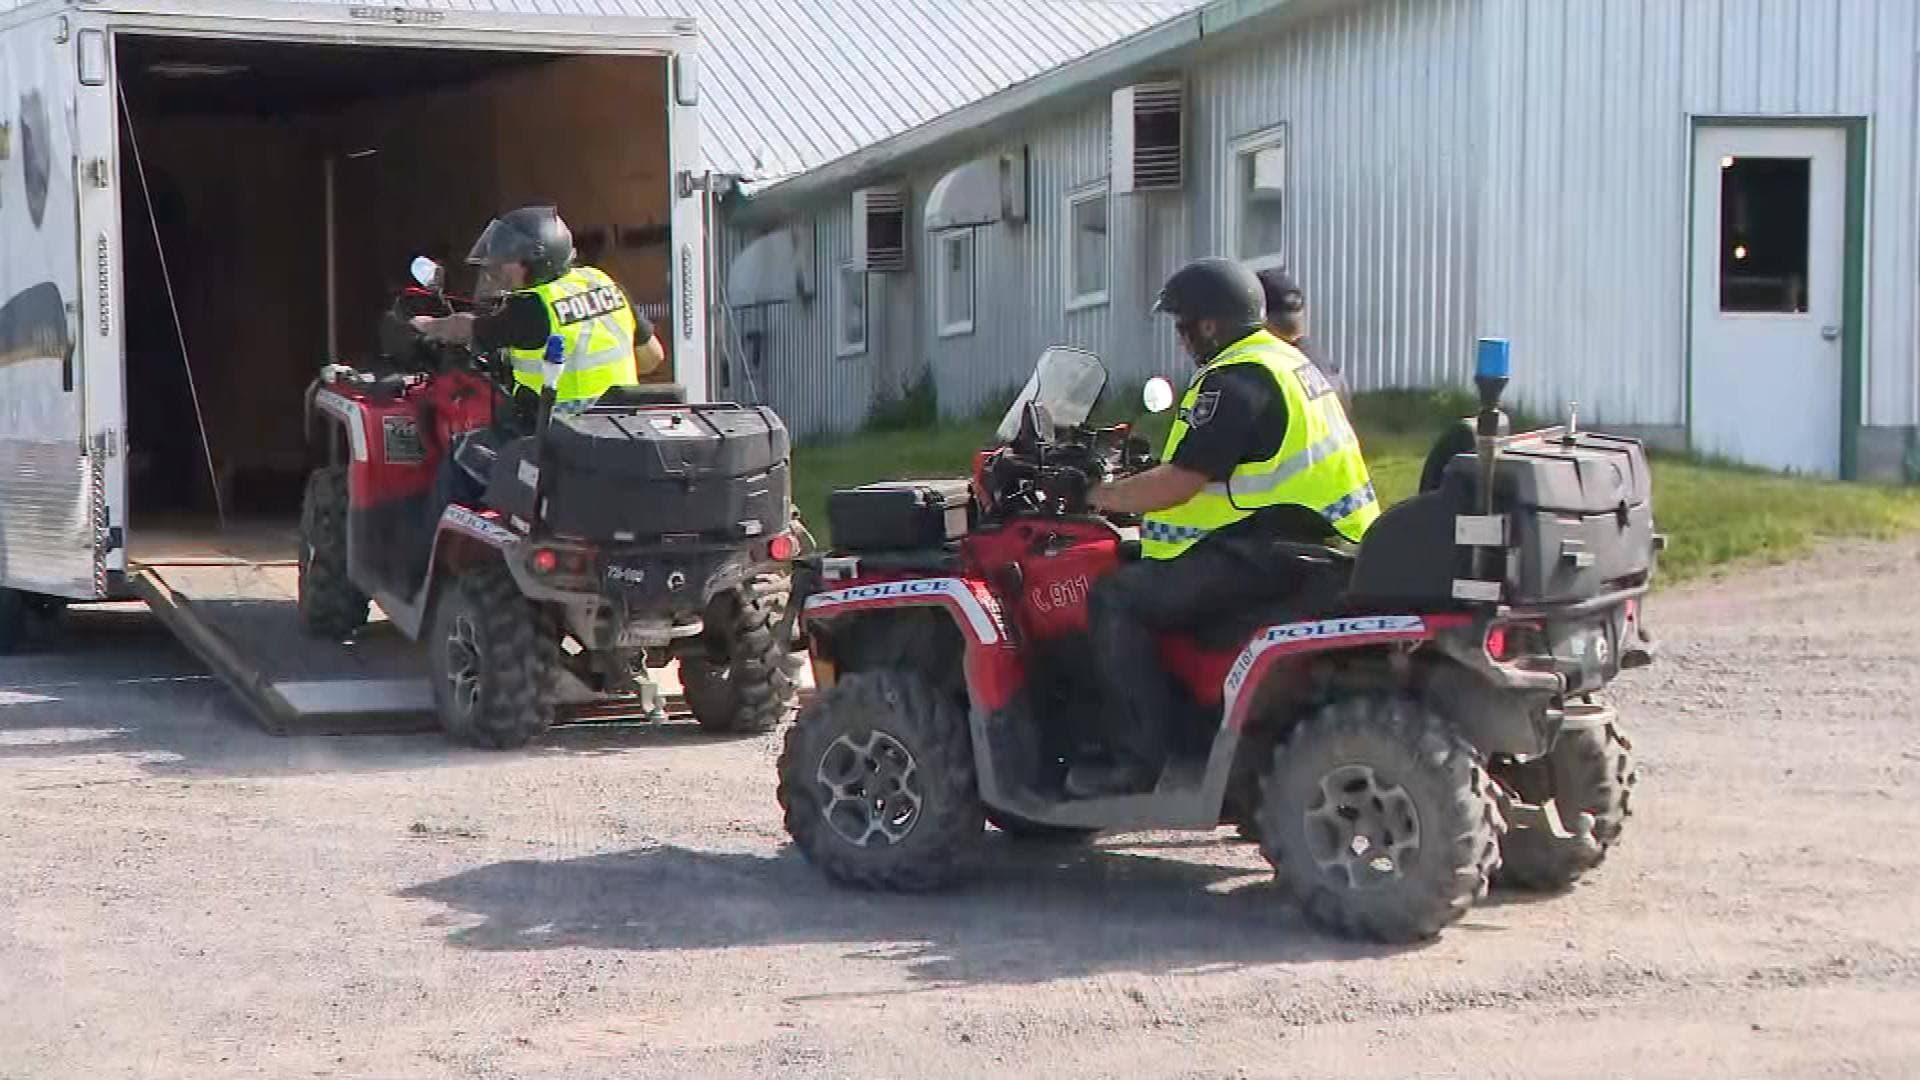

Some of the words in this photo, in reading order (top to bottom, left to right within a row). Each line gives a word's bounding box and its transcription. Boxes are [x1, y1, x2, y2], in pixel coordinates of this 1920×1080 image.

[554, 287, 624, 323] POLICE
[842, 580, 950, 600] POLICE
[1049, 575, 1089, 607] 911
[1268, 618, 1396, 641] POLICE
